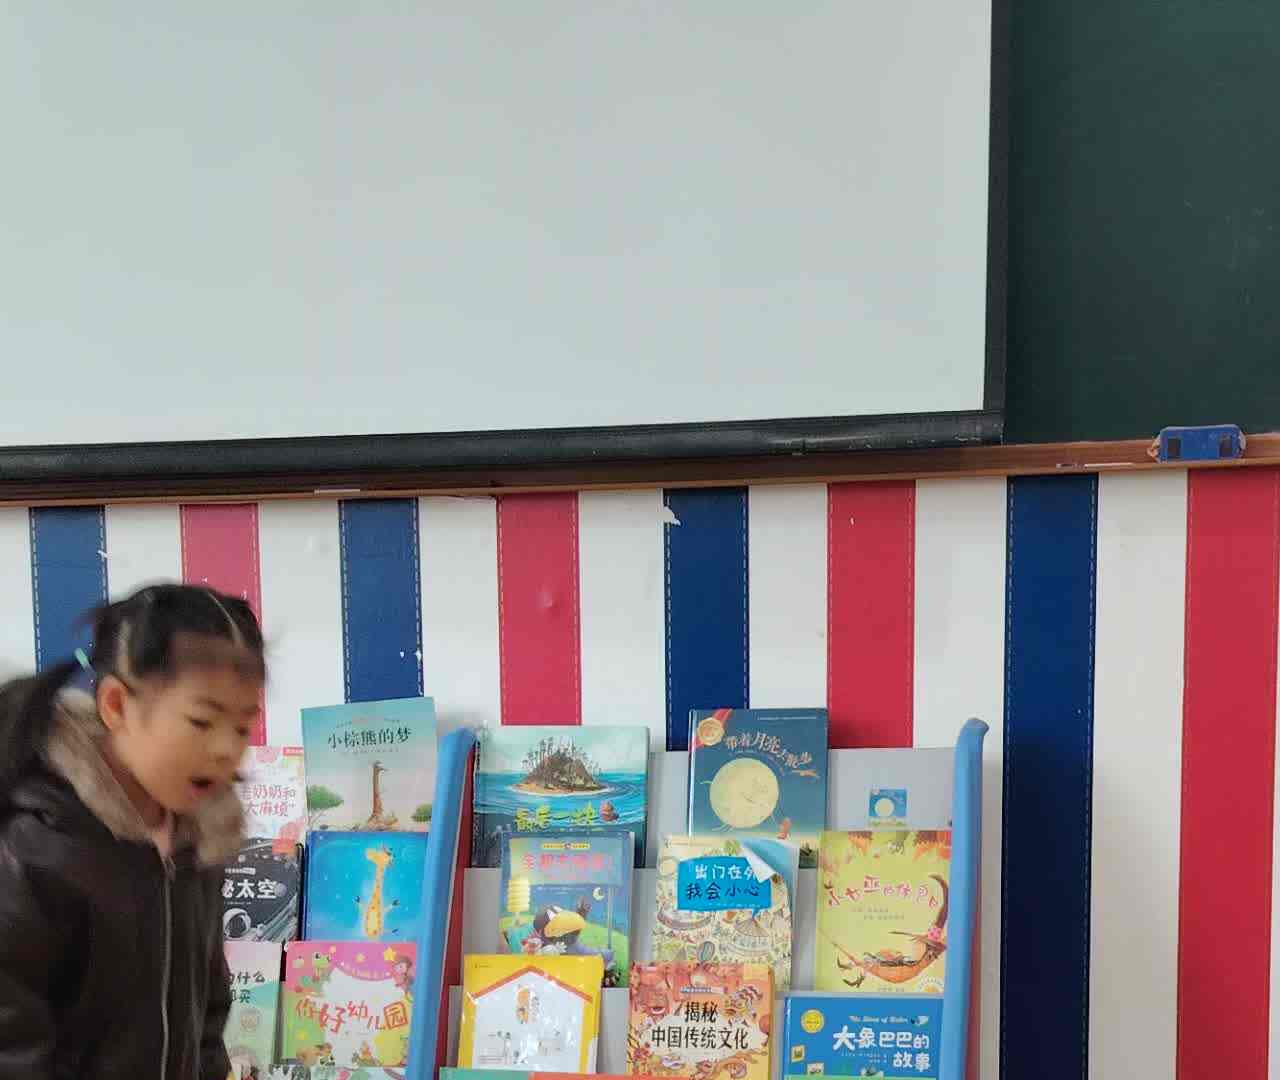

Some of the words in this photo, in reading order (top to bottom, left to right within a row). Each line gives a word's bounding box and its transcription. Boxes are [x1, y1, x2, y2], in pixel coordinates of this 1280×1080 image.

[328, 727, 412, 749] 小棕熊的梦
[685, 883, 761, 901] 我会小心
[295, 999, 409, 1033] 你好幼儿园
[684, 1001, 720, 1025] 揭秘
[651, 1026, 750, 1051] 中国传统文化
[832, 1025, 930, 1051] 大象巴巴的
[892, 1051, 931, 1073] 故事
